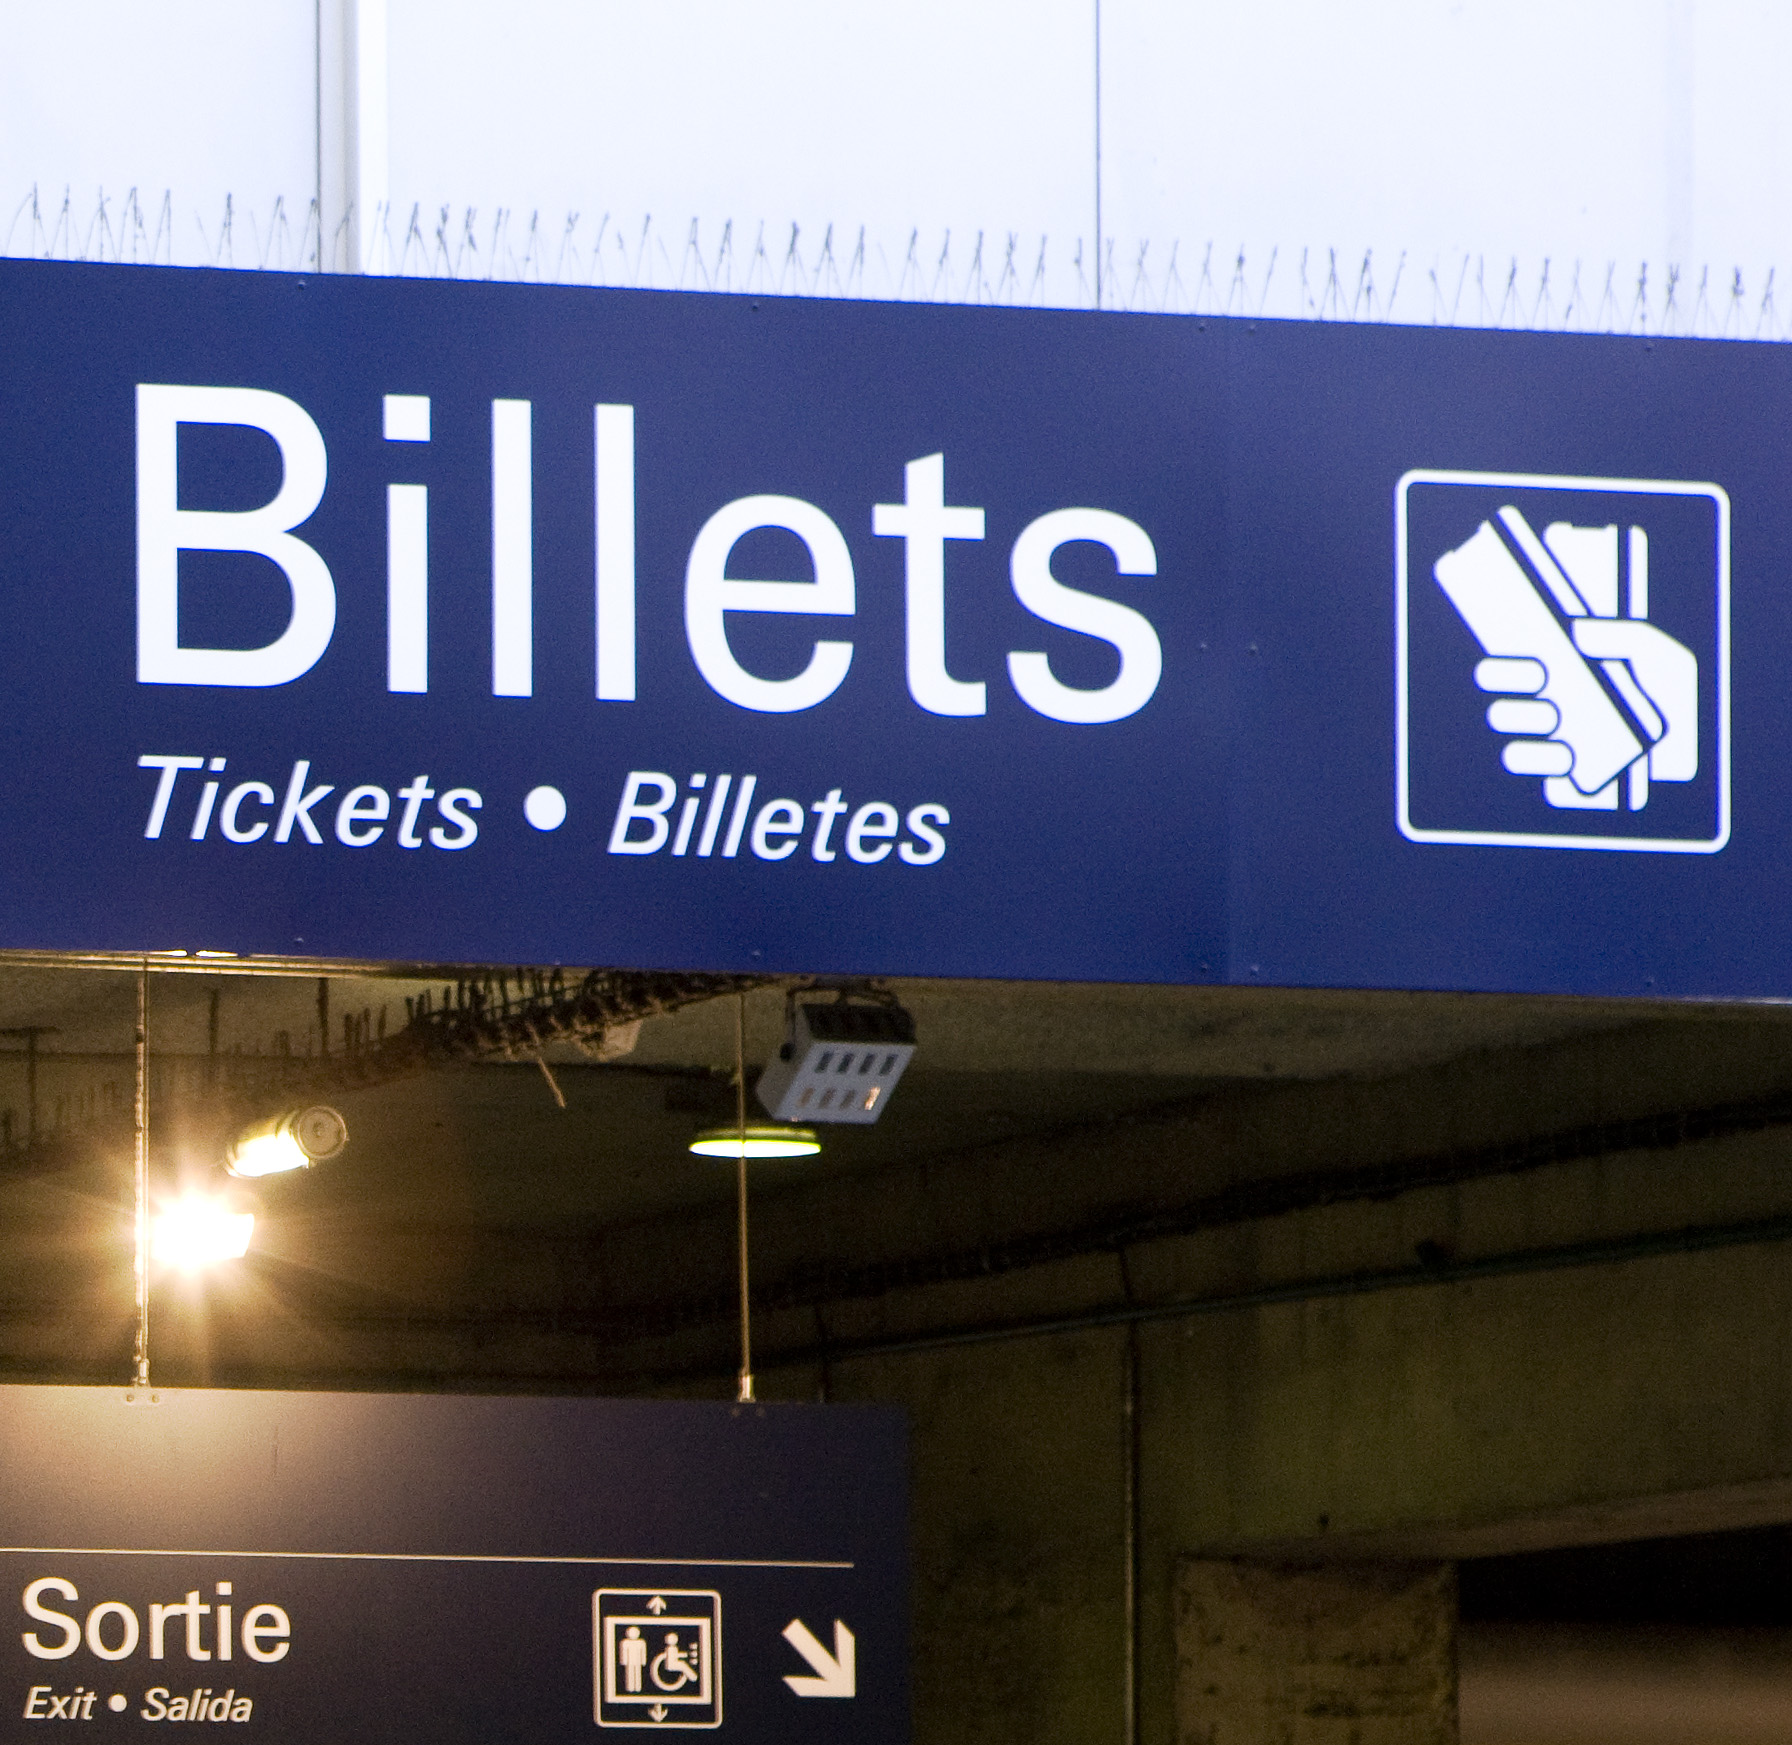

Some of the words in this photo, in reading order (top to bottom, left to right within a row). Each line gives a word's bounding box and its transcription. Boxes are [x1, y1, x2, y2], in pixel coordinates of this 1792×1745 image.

[135, 382, 1164, 725] Billets
[137, 754, 484, 850] Tickets
[608, 770, 951, 866] Billetes
[22, 1576, 292, 1664] Sortie
[24, 1685, 98, 1722] Exit
[141, 1686, 254, 1724] Salida
